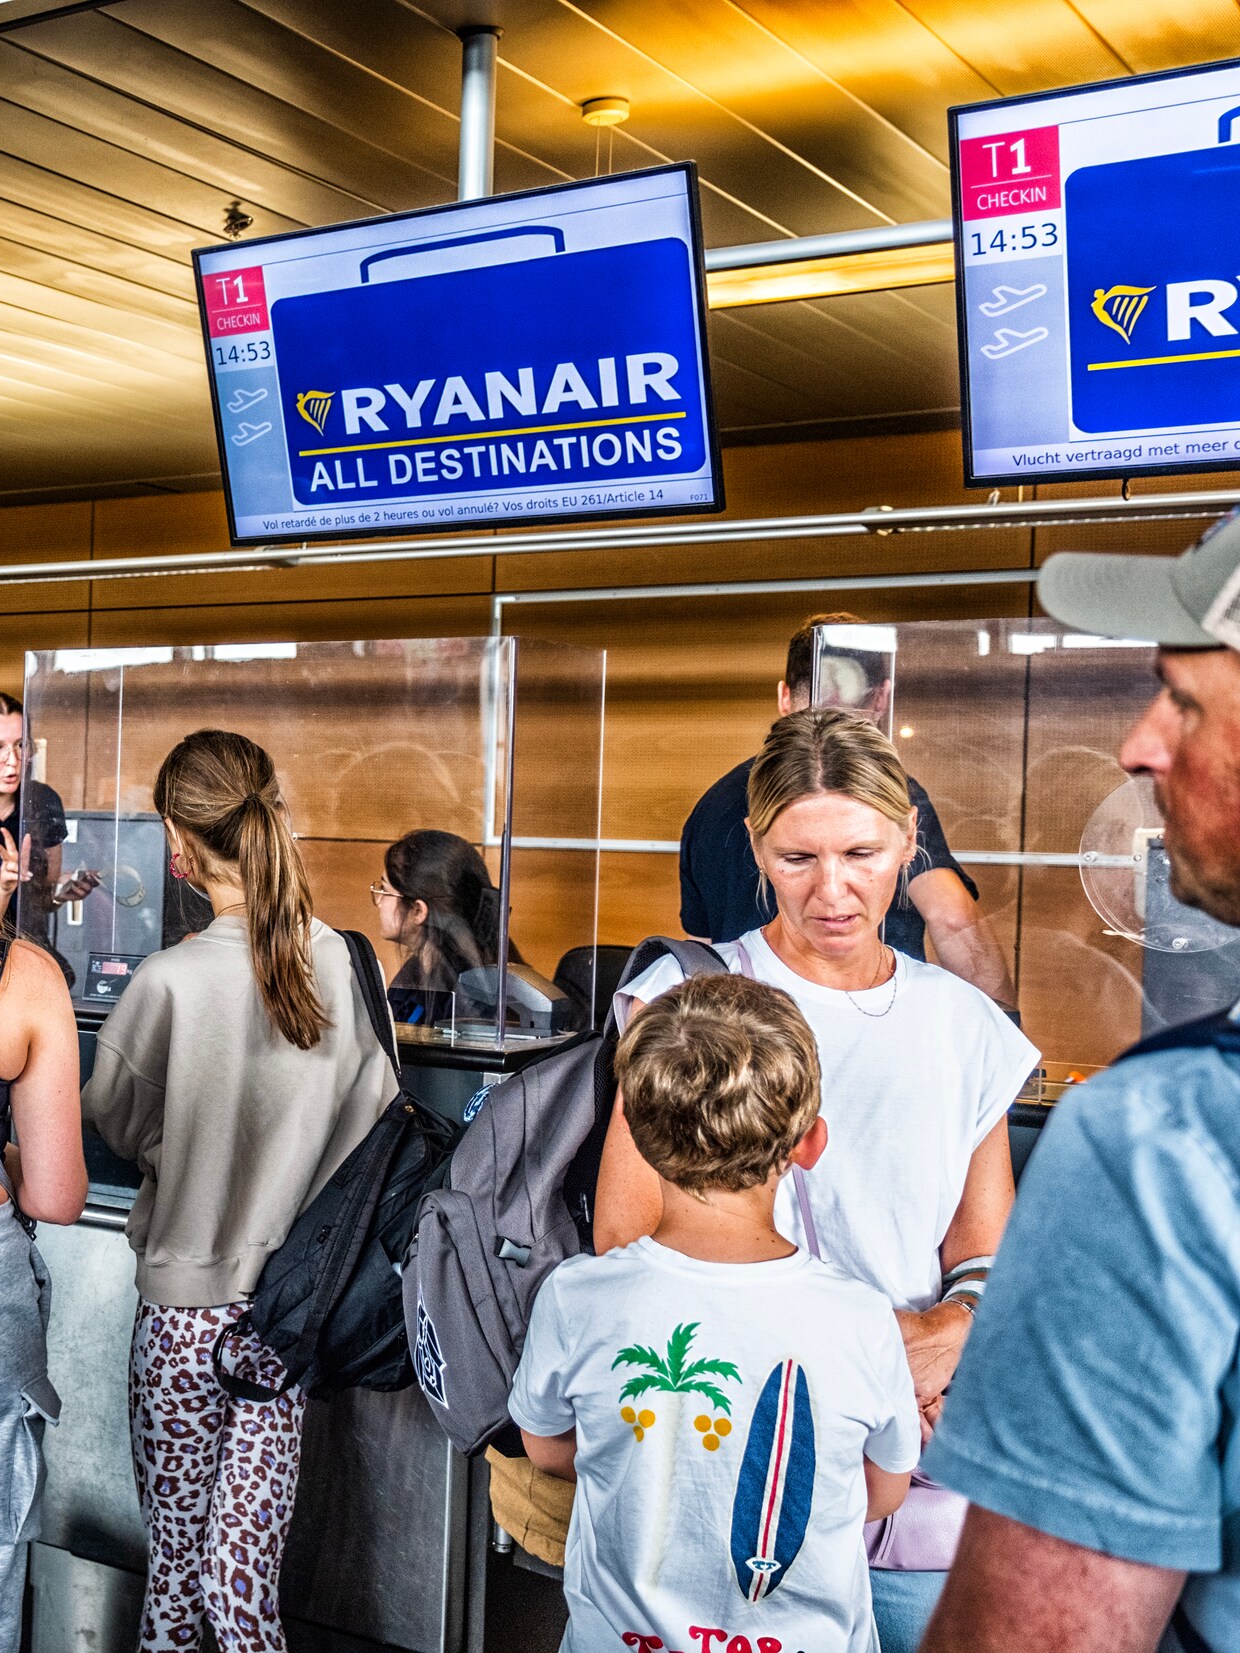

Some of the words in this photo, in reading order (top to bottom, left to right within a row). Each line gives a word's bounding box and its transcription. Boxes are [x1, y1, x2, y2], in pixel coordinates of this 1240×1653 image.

[982, 137, 1032, 178] T1
[976, 186, 1047, 211] CHECKIN
[971, 222, 1058, 256] 14:53
[216, 275, 249, 306] T1
[216, 311, 261, 331] CHECKIN
[1166, 274, 1240, 342] R
[215, 341, 271, 367] 14:53
[341, 352, 682, 435] RYANAIR
[310, 457, 378, 492] ALL
[389, 427, 682, 486] DESTINATIONS
[1012, 452, 1061, 466] Vlucht
[1065, 445, 1142, 462] vertraagd
[1148, 443, 1180, 457] met
[1186, 440, 1229, 454] meer
[263, 520, 278, 530] Vol
[281, 516, 316, 529] retardé
[320, 516, 332, 526] de
[335, 514, 355, 526] plus
[358, 512, 371, 523] de
[374, 511, 380, 521] 2
[384, 510, 419, 521] heures
[422, 510, 435, 518] ou
[439, 506, 454, 517] vol
[457, 501, 499, 515] annulé?
[503, 501, 523, 512] Vos
[526, 497, 559, 510] droits
[562, 496, 577, 507] EU
[581, 490, 645, 506] 261/Article
[650, 489, 664, 500] 14
